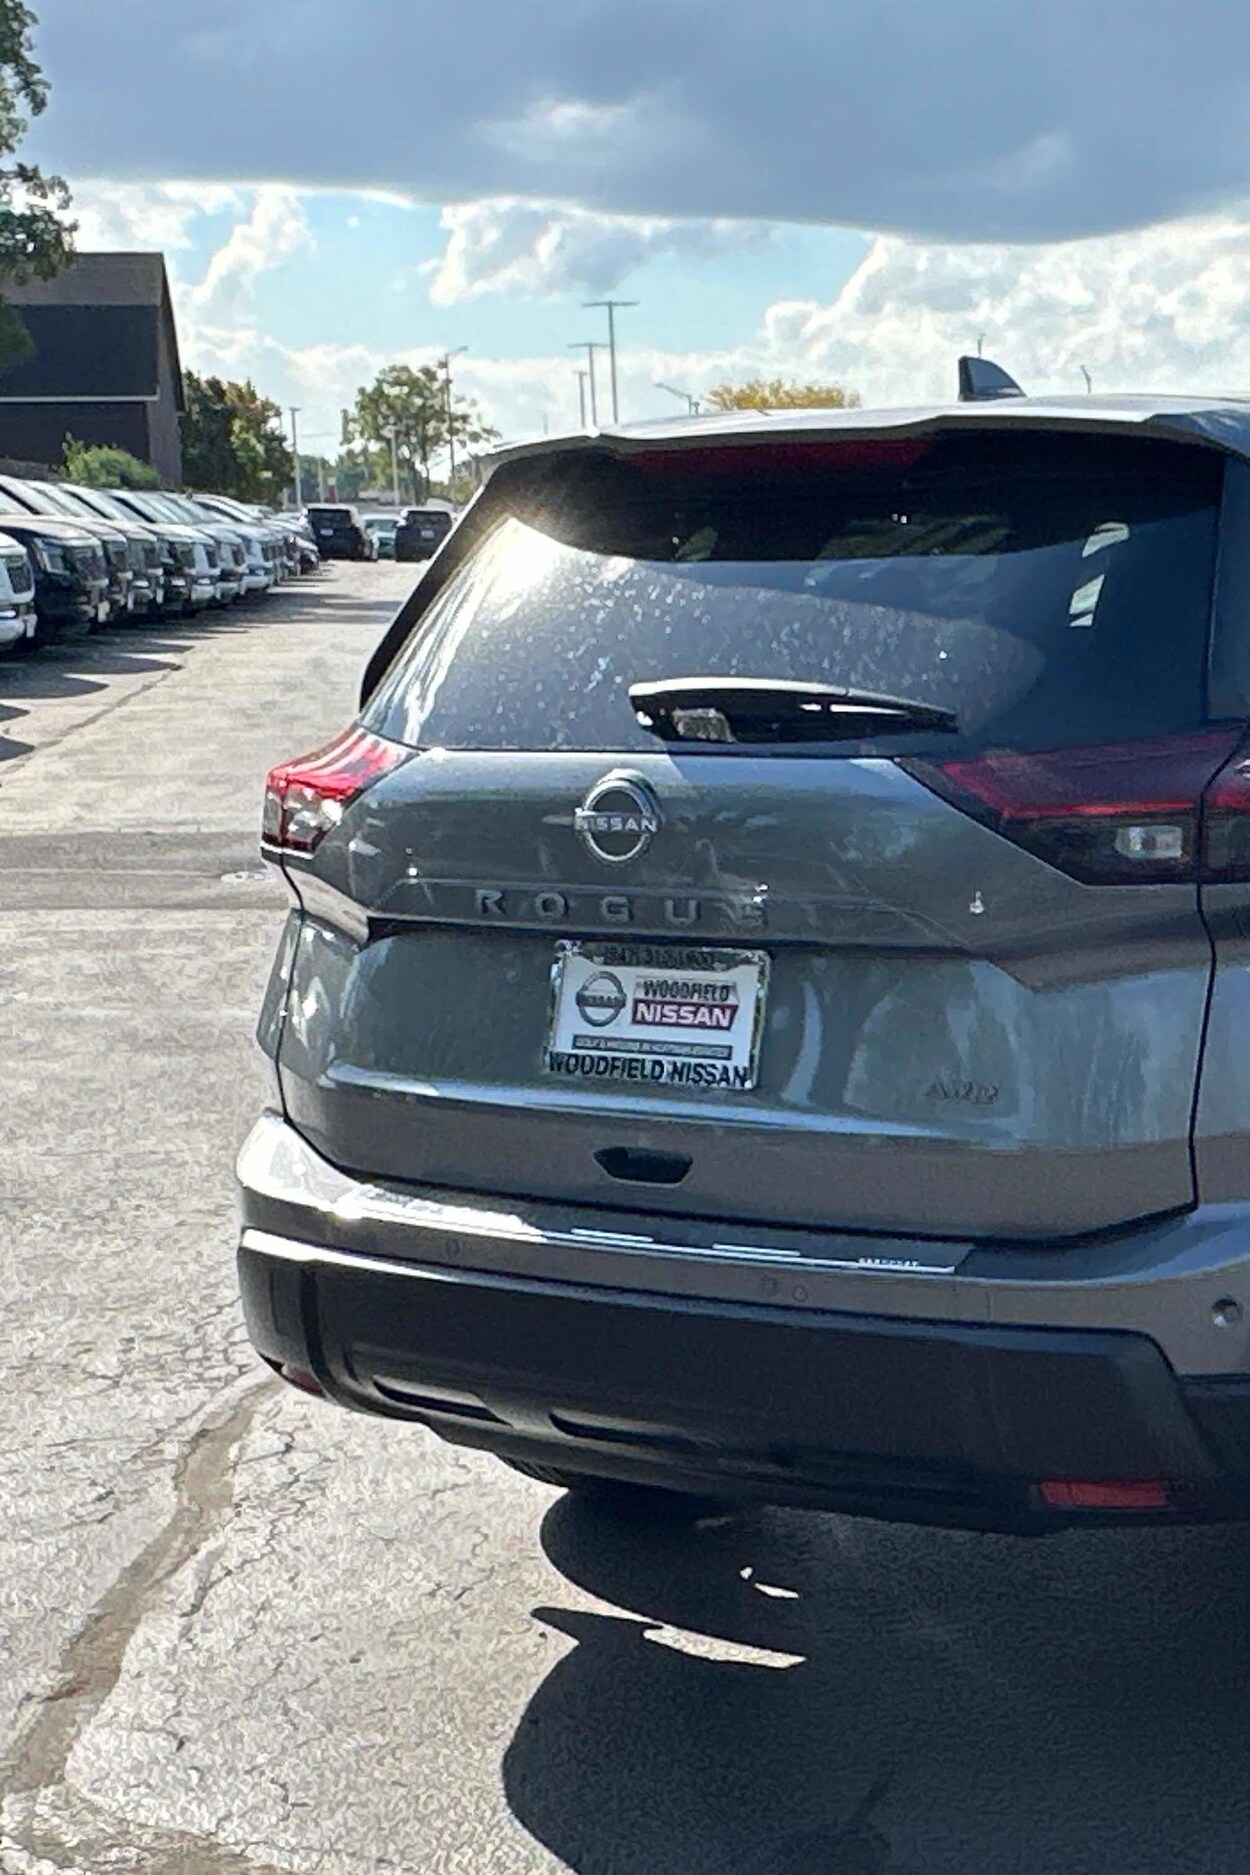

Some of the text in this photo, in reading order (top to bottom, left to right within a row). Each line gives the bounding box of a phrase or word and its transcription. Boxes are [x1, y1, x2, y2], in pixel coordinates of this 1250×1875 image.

[574, 815, 657, 833] NISSAN
[474, 888, 768, 928] ROGUE
[643, 979, 731, 1002] WOODFIELD
[635, 1002, 732, 1028] NISSAN
[549, 1052, 748, 1088] WOODFIELD NISSAN
